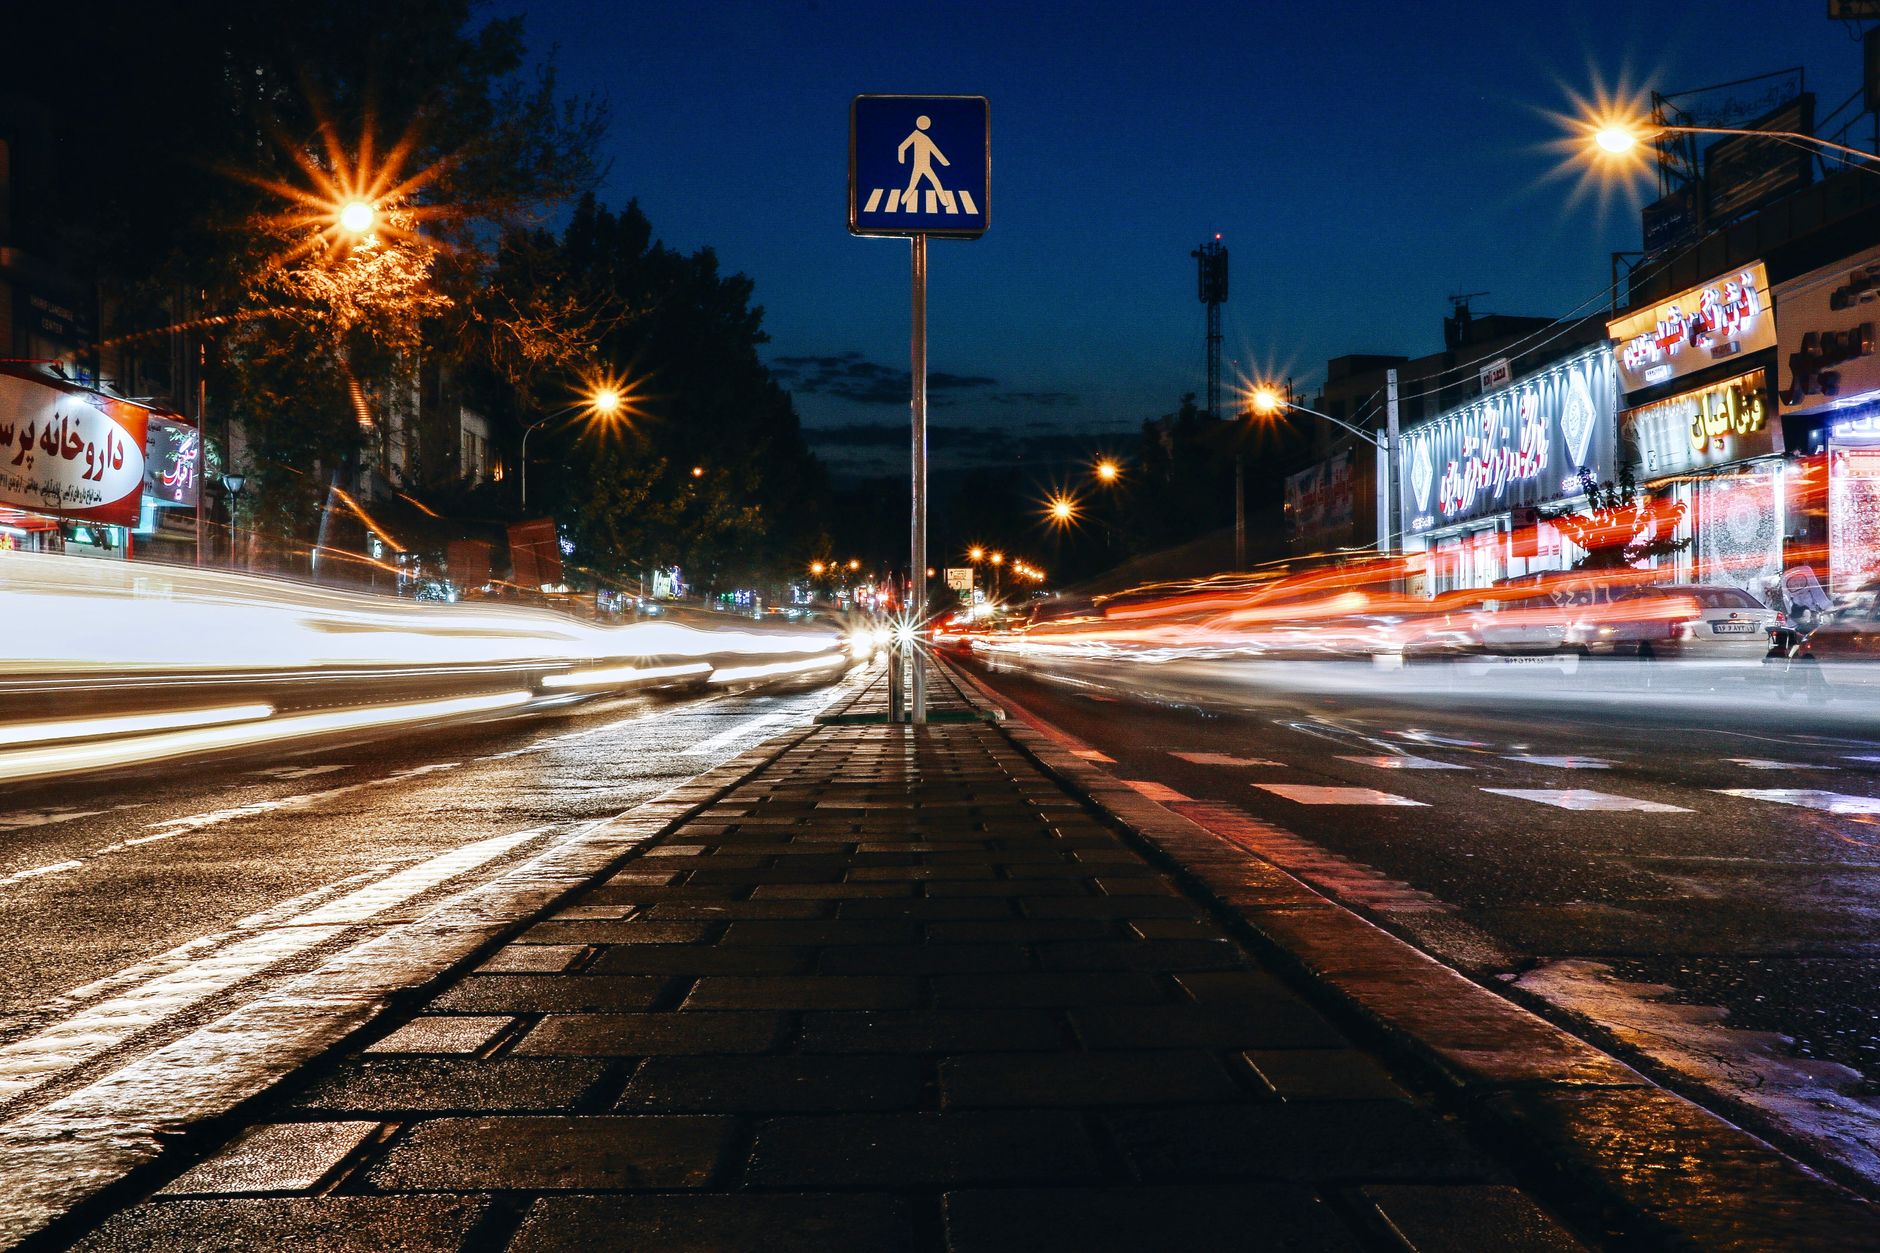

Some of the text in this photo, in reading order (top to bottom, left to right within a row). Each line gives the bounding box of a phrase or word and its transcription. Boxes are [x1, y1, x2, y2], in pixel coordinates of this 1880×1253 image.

[1690, 385, 1737, 451] اعیان
[1736, 389, 1761, 435] فرش
[39, 411, 124, 482] داروخانه
